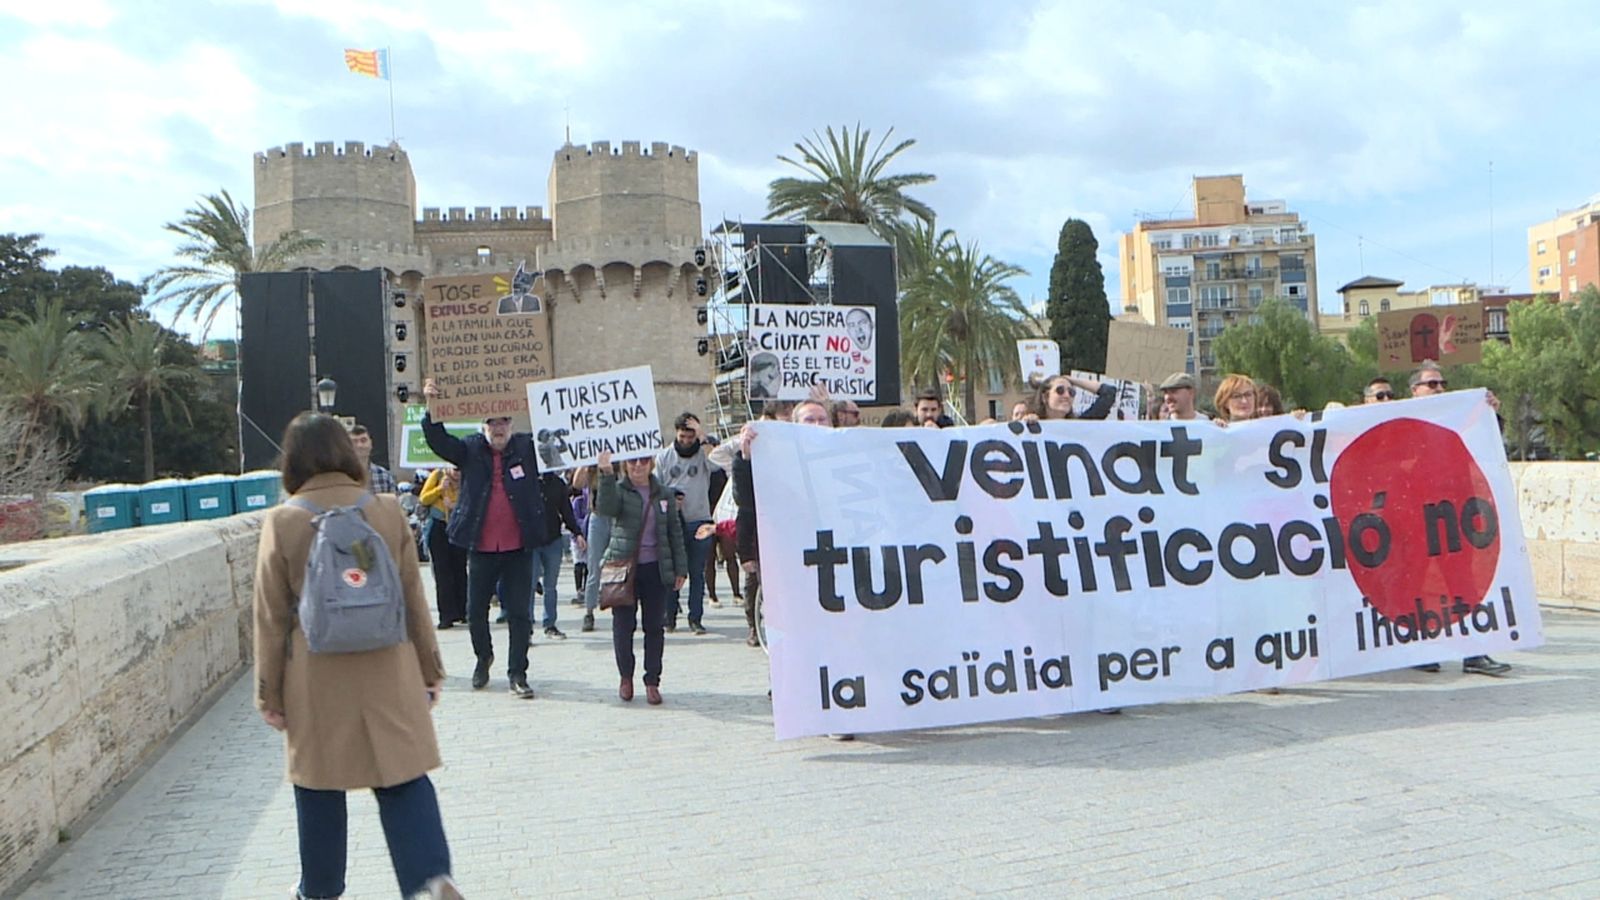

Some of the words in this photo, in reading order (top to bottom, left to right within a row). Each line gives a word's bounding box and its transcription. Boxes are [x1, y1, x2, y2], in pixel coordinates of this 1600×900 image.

[430, 301, 492, 318] EXPULSÓ
[754, 308, 778, 328] LA
[785, 309, 846, 329] NOSTRA
[431, 321, 439, 333] A
[442, 320, 455, 332] LA
[506, 318, 533, 328] QUE
[463, 333, 478, 343] EN
[481, 332, 502, 341] UNA
[504, 329, 535, 341] CASA
[432, 345, 480, 360] PORQUE
[483, 344, 498, 355] SU
[501, 341, 543, 354] CUÑADO
[760, 332, 820, 351] CIUTAT
[826, 336, 850, 354] NO
[433, 362, 447, 373] LE
[452, 359, 479, 371] DIJO
[484, 357, 507, 367] QUE
[513, 354, 539, 365] ERA
[782, 352, 799, 370] ÉS
[805, 356, 821, 370] EL
[824, 356, 851, 370] TEU
[484, 370, 494, 381] SI
[498, 370, 515, 380] NO
[783, 371, 820, 388] PARC
[819, 375, 875, 397] TURÍSTIC
[540, 391, 551, 415] 1
[555, 380, 638, 411] TURISTA
[436, 404, 454, 418] NO
[458, 402, 490, 417] SEAS
[491, 400, 520, 415] COMO
[570, 409, 612, 431] MÉS,
[611, 404, 648, 424] UNA
[568, 437, 615, 461] VEÏNA
[616, 430, 661, 453] MENYS
[896, 421, 1202, 502] veïnat
[803, 492, 1392, 613] turistificació
[1424, 496, 1498, 556] no
[819, 665, 867, 710] la
[900, 645, 1073, 706] saïdia
[1098, 646, 1182, 692] per
[1205, 637, 1235, 671] a
[1255, 614, 1319, 671] qui
